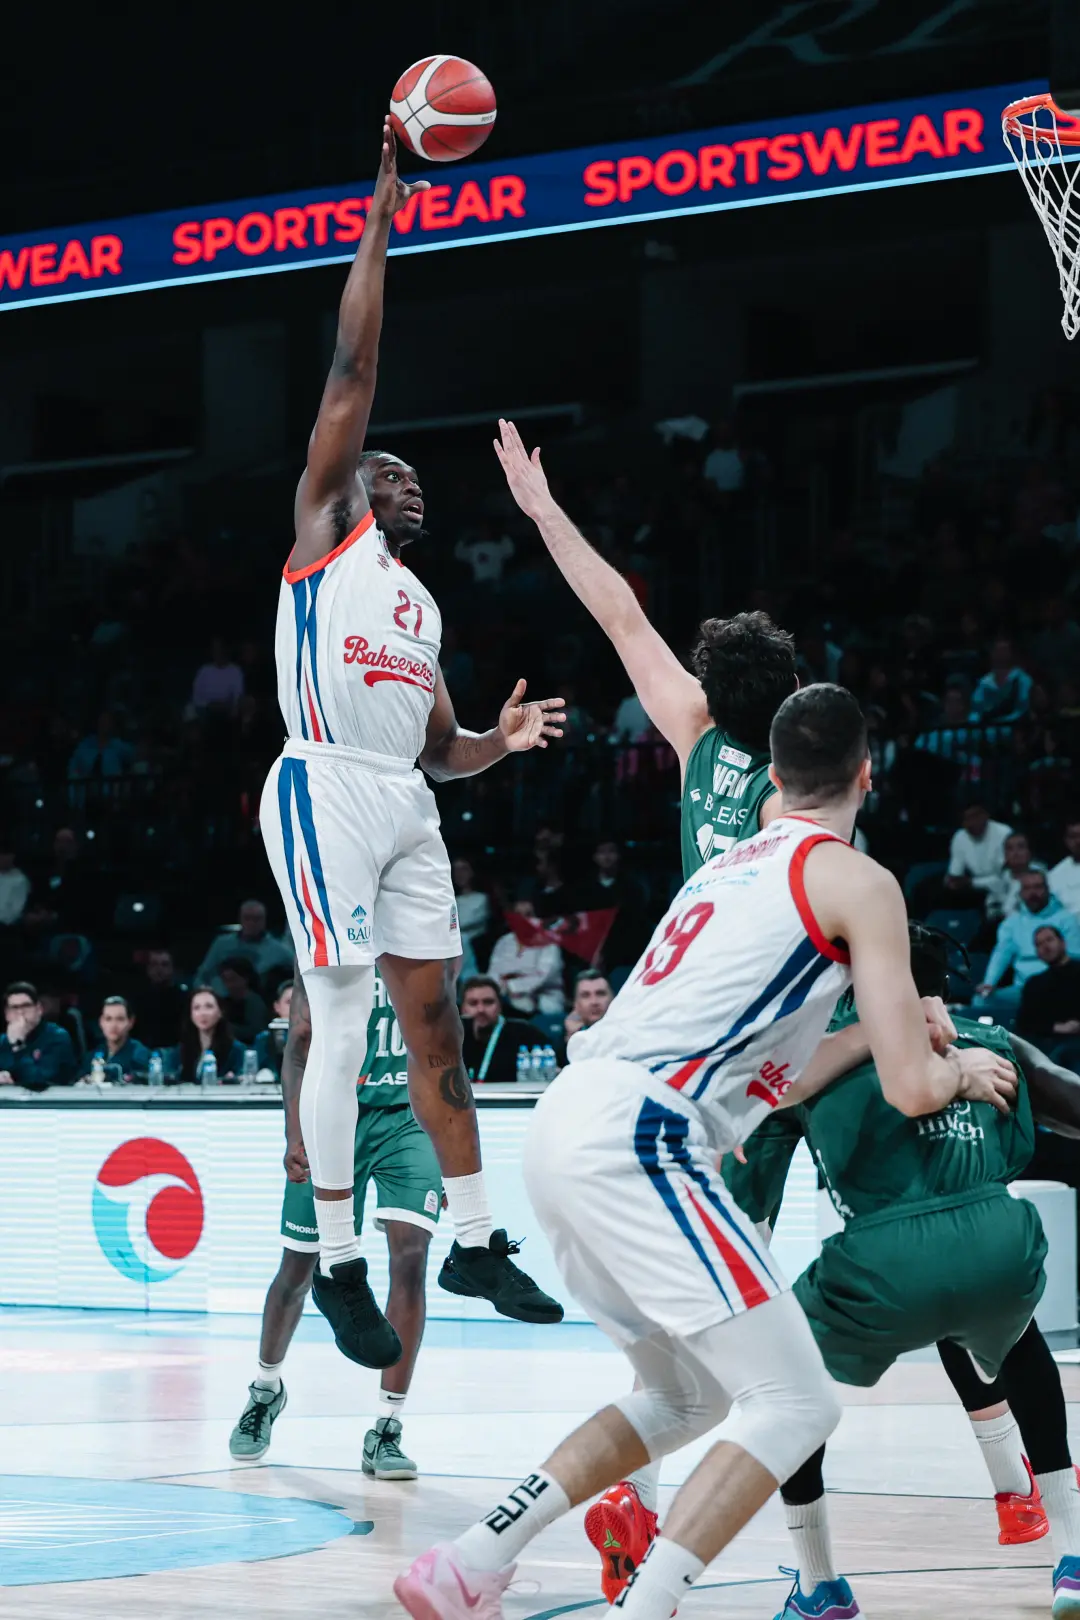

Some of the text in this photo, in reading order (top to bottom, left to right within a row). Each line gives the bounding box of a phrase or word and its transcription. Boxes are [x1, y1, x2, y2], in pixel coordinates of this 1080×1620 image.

[583, 108, 985, 207] SPORTSWEAR
[392, 588, 424, 639] 21
[346, 925, 371, 941] BAU
[375, 1016, 408, 1058] 10
